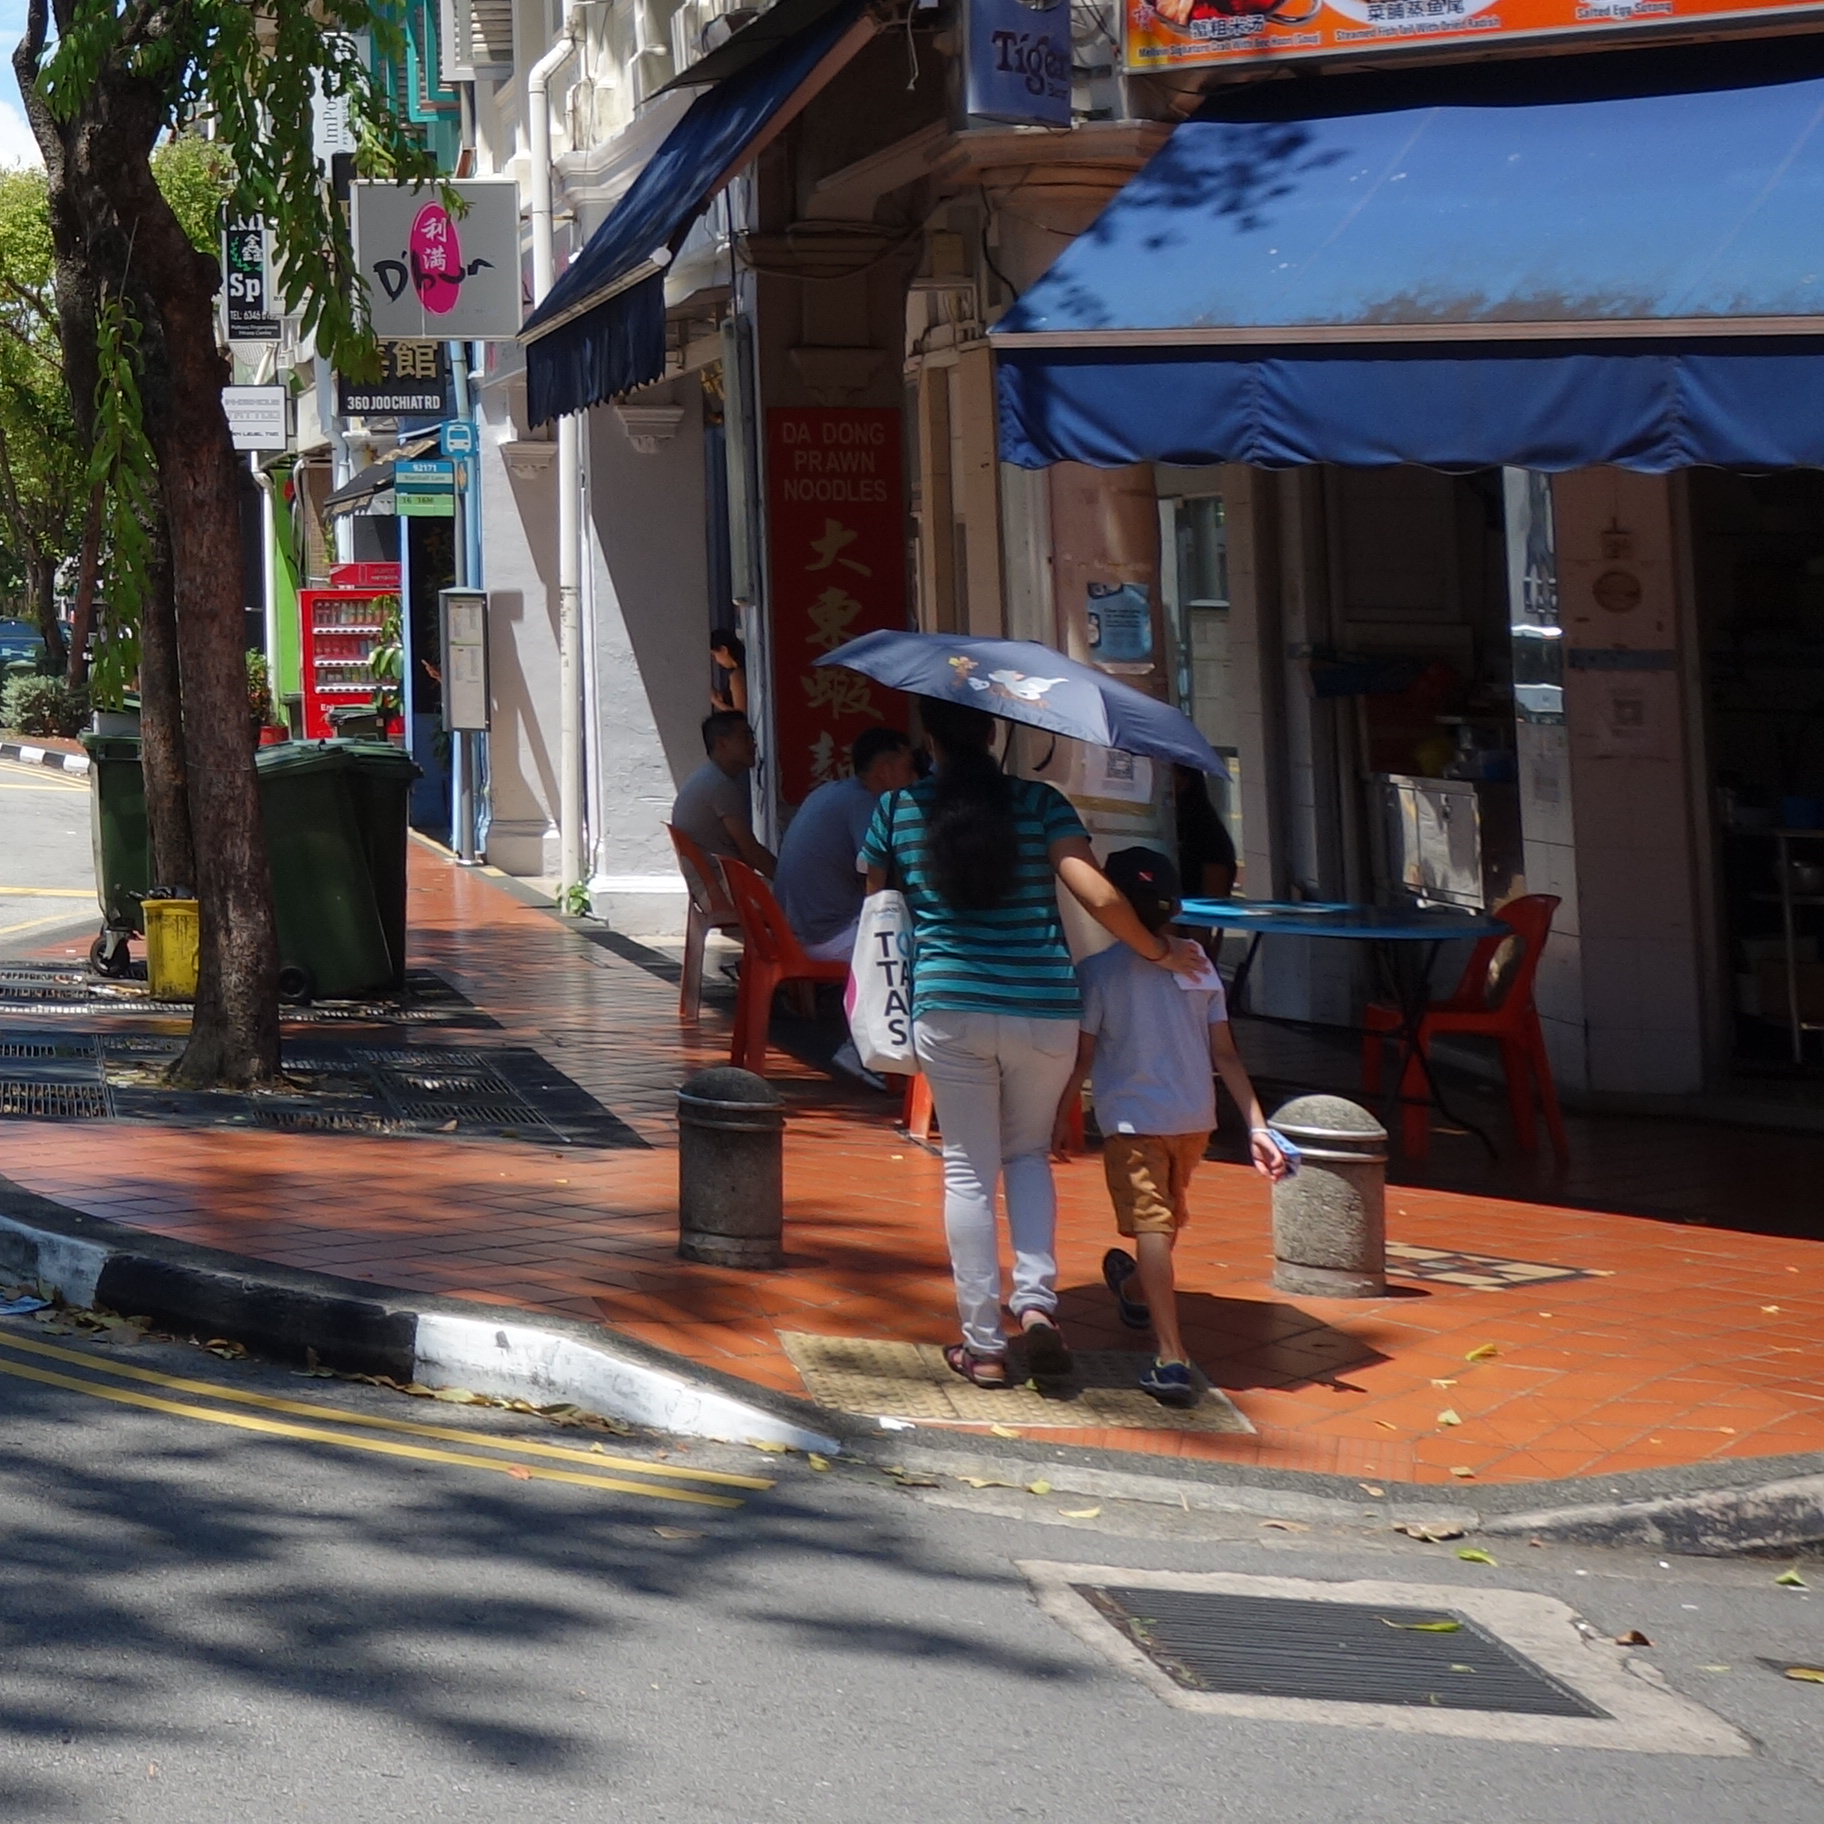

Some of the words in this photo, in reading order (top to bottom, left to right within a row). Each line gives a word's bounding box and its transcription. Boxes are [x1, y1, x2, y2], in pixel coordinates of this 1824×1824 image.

[1577, 5, 1612, 20] Salted
[1613, 4, 1633, 18] Egg
[991, 31, 1071, 95] Tiger
[347, 396, 370, 409] 360
[370, 396, 390, 411] JOO
[391, 395, 424, 410] CHIAT
[425, 395, 441, 409] RD
[782, 423, 811, 444] DA
[822, 423, 885, 445] DONG
[795, 451, 875, 473] PRAWN
[784, 479, 887, 502] NOODLES
